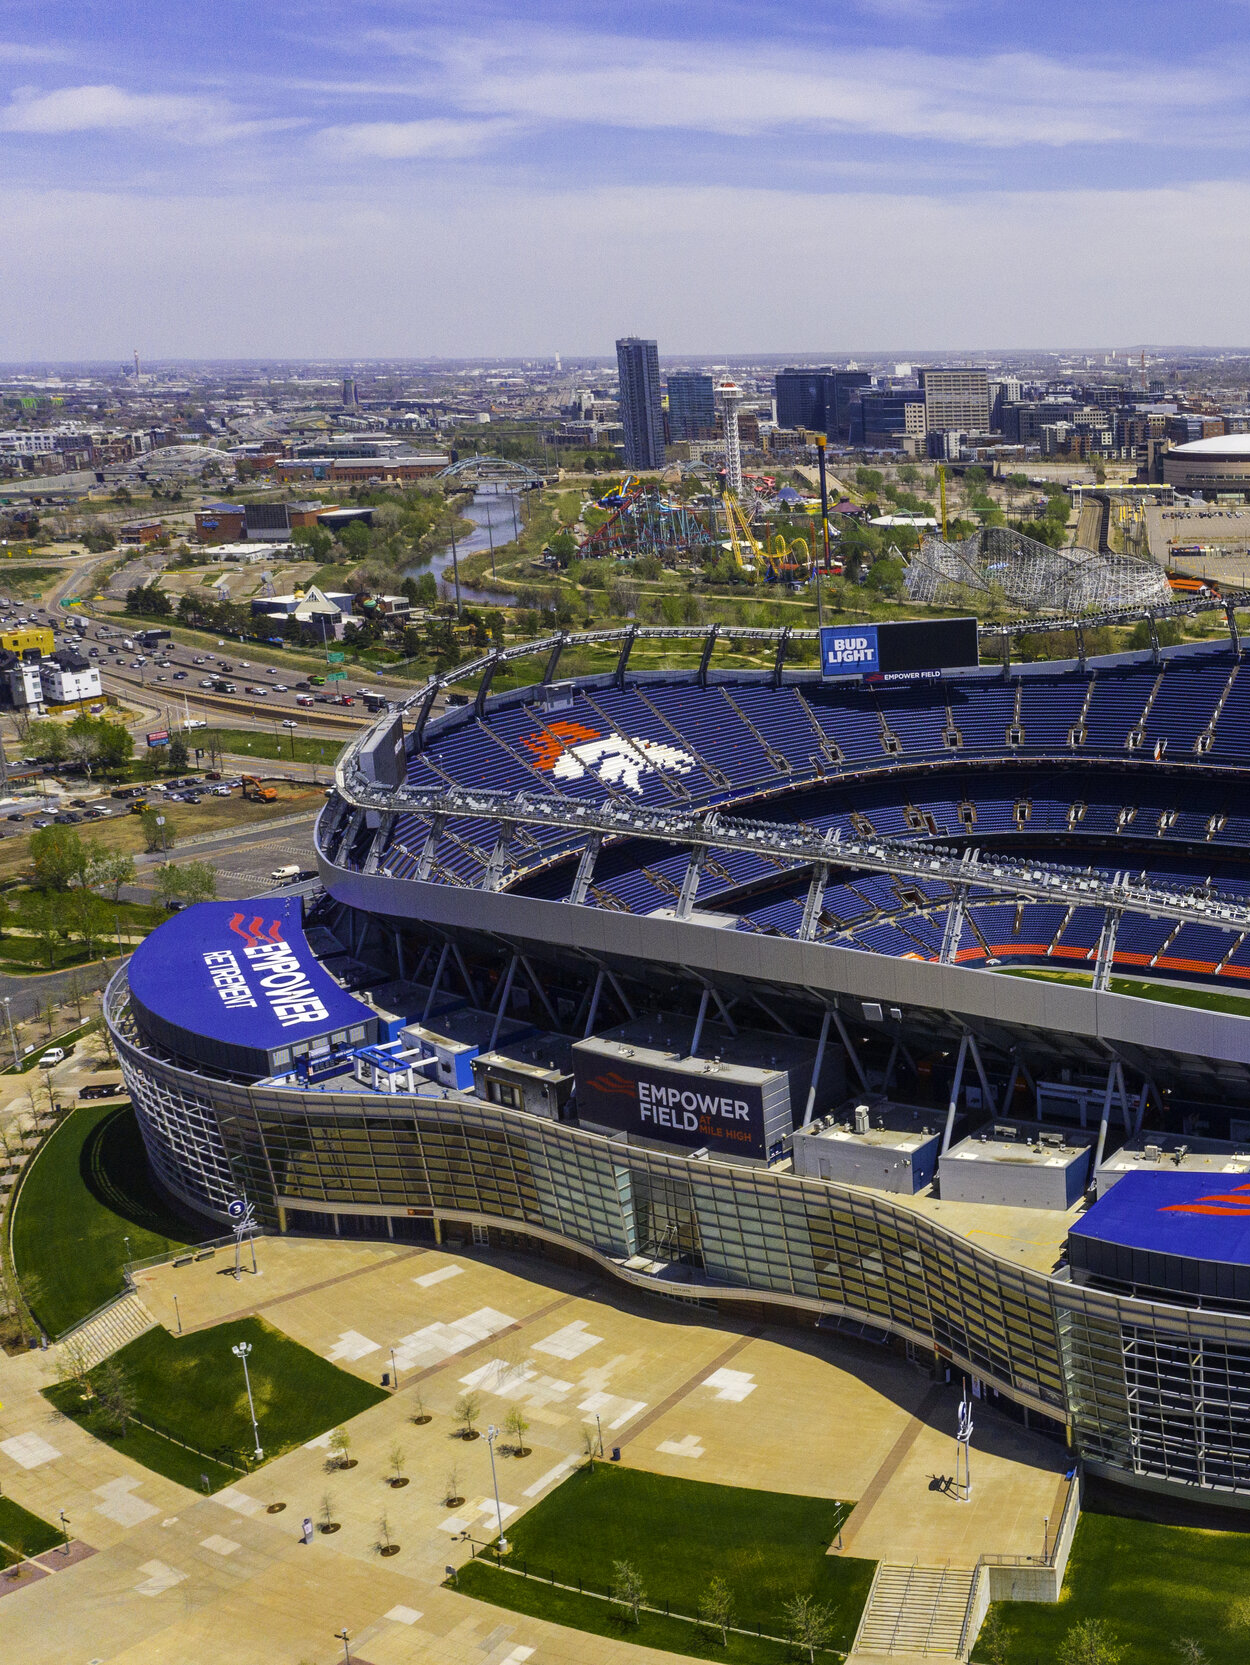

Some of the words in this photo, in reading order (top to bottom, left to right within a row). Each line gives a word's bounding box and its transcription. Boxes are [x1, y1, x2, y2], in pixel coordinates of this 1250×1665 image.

[828, 649, 874, 663] LIGHT
[834, 638, 867, 650] BUD
[202, 950, 258, 1009] RETIREMENT
[243, 941, 329, 1027] EMPOWER
[637, 1081, 750, 1121] EMPOWER
[639, 1102, 699, 1132] FIELD
[699, 1115, 711, 1124] AT
[700, 1124, 722, 1137] MILE
[725, 1129, 752, 1142] HIGH
[233, 1205, 242, 1214] 3
